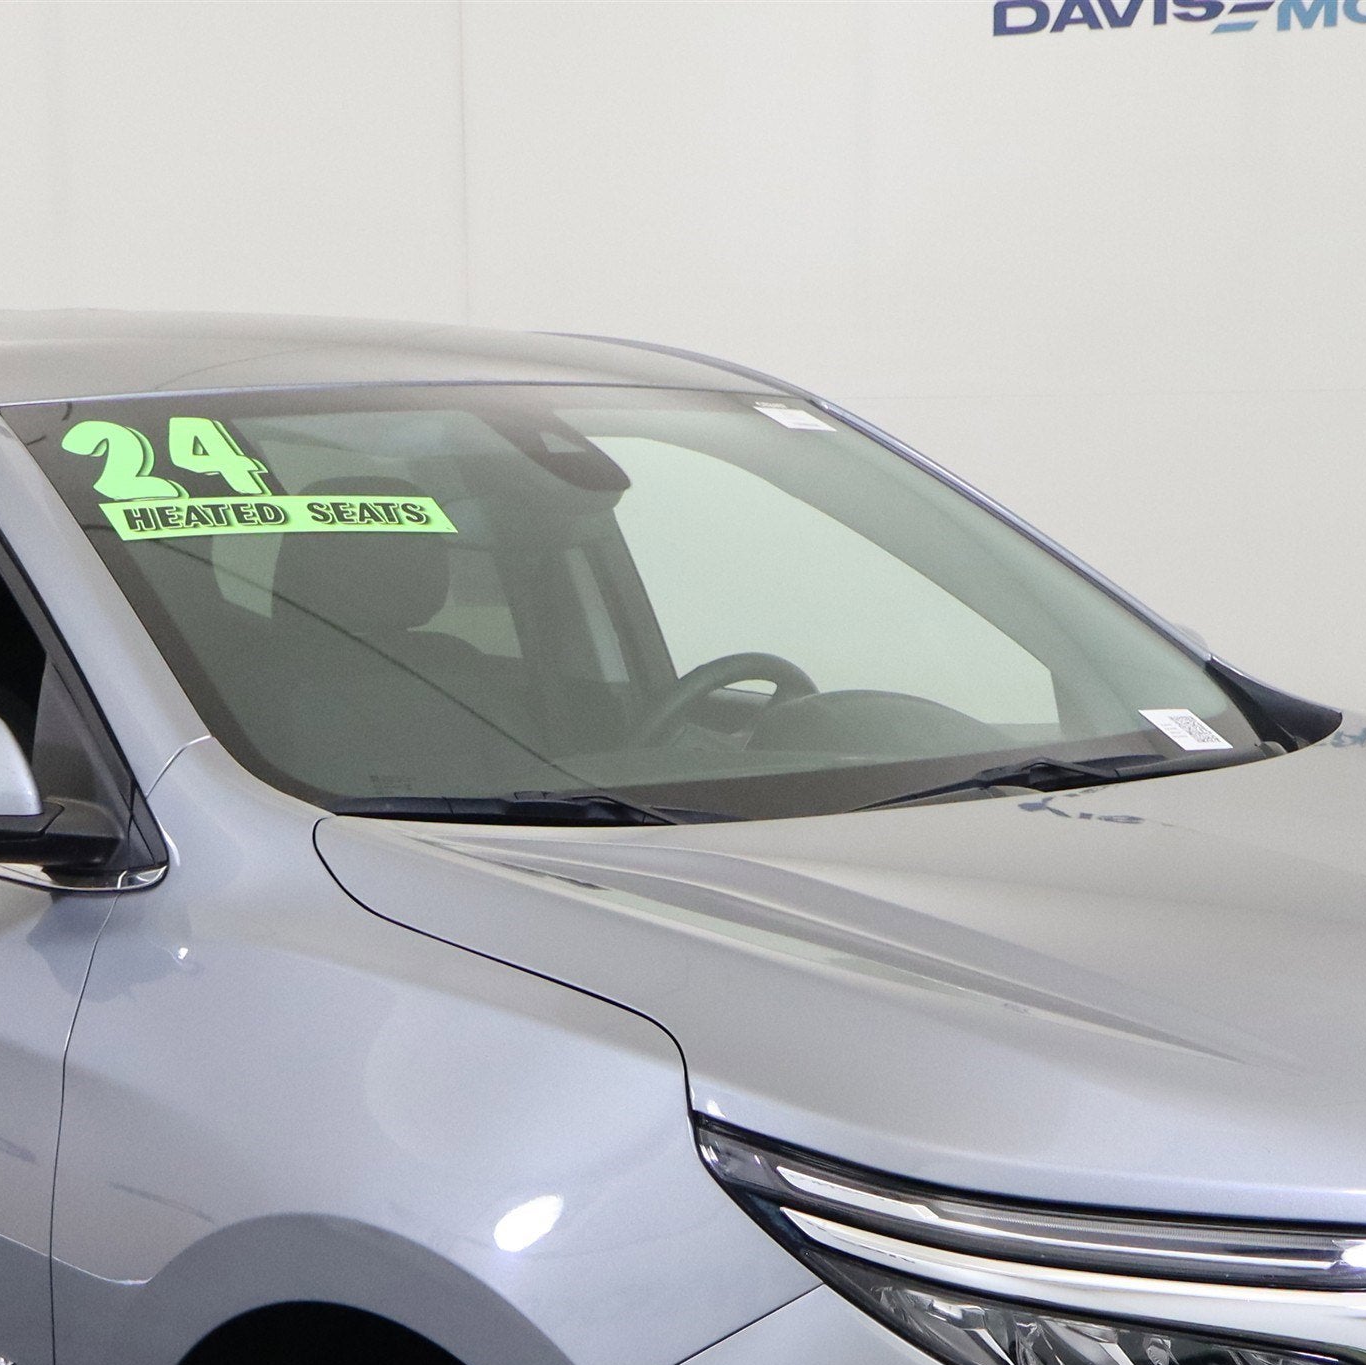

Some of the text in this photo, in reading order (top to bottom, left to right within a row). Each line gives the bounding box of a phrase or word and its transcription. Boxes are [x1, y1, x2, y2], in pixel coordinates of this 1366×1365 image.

[61, 416, 273, 500] 24
[123, 501, 431, 531] HEATED SEATS
